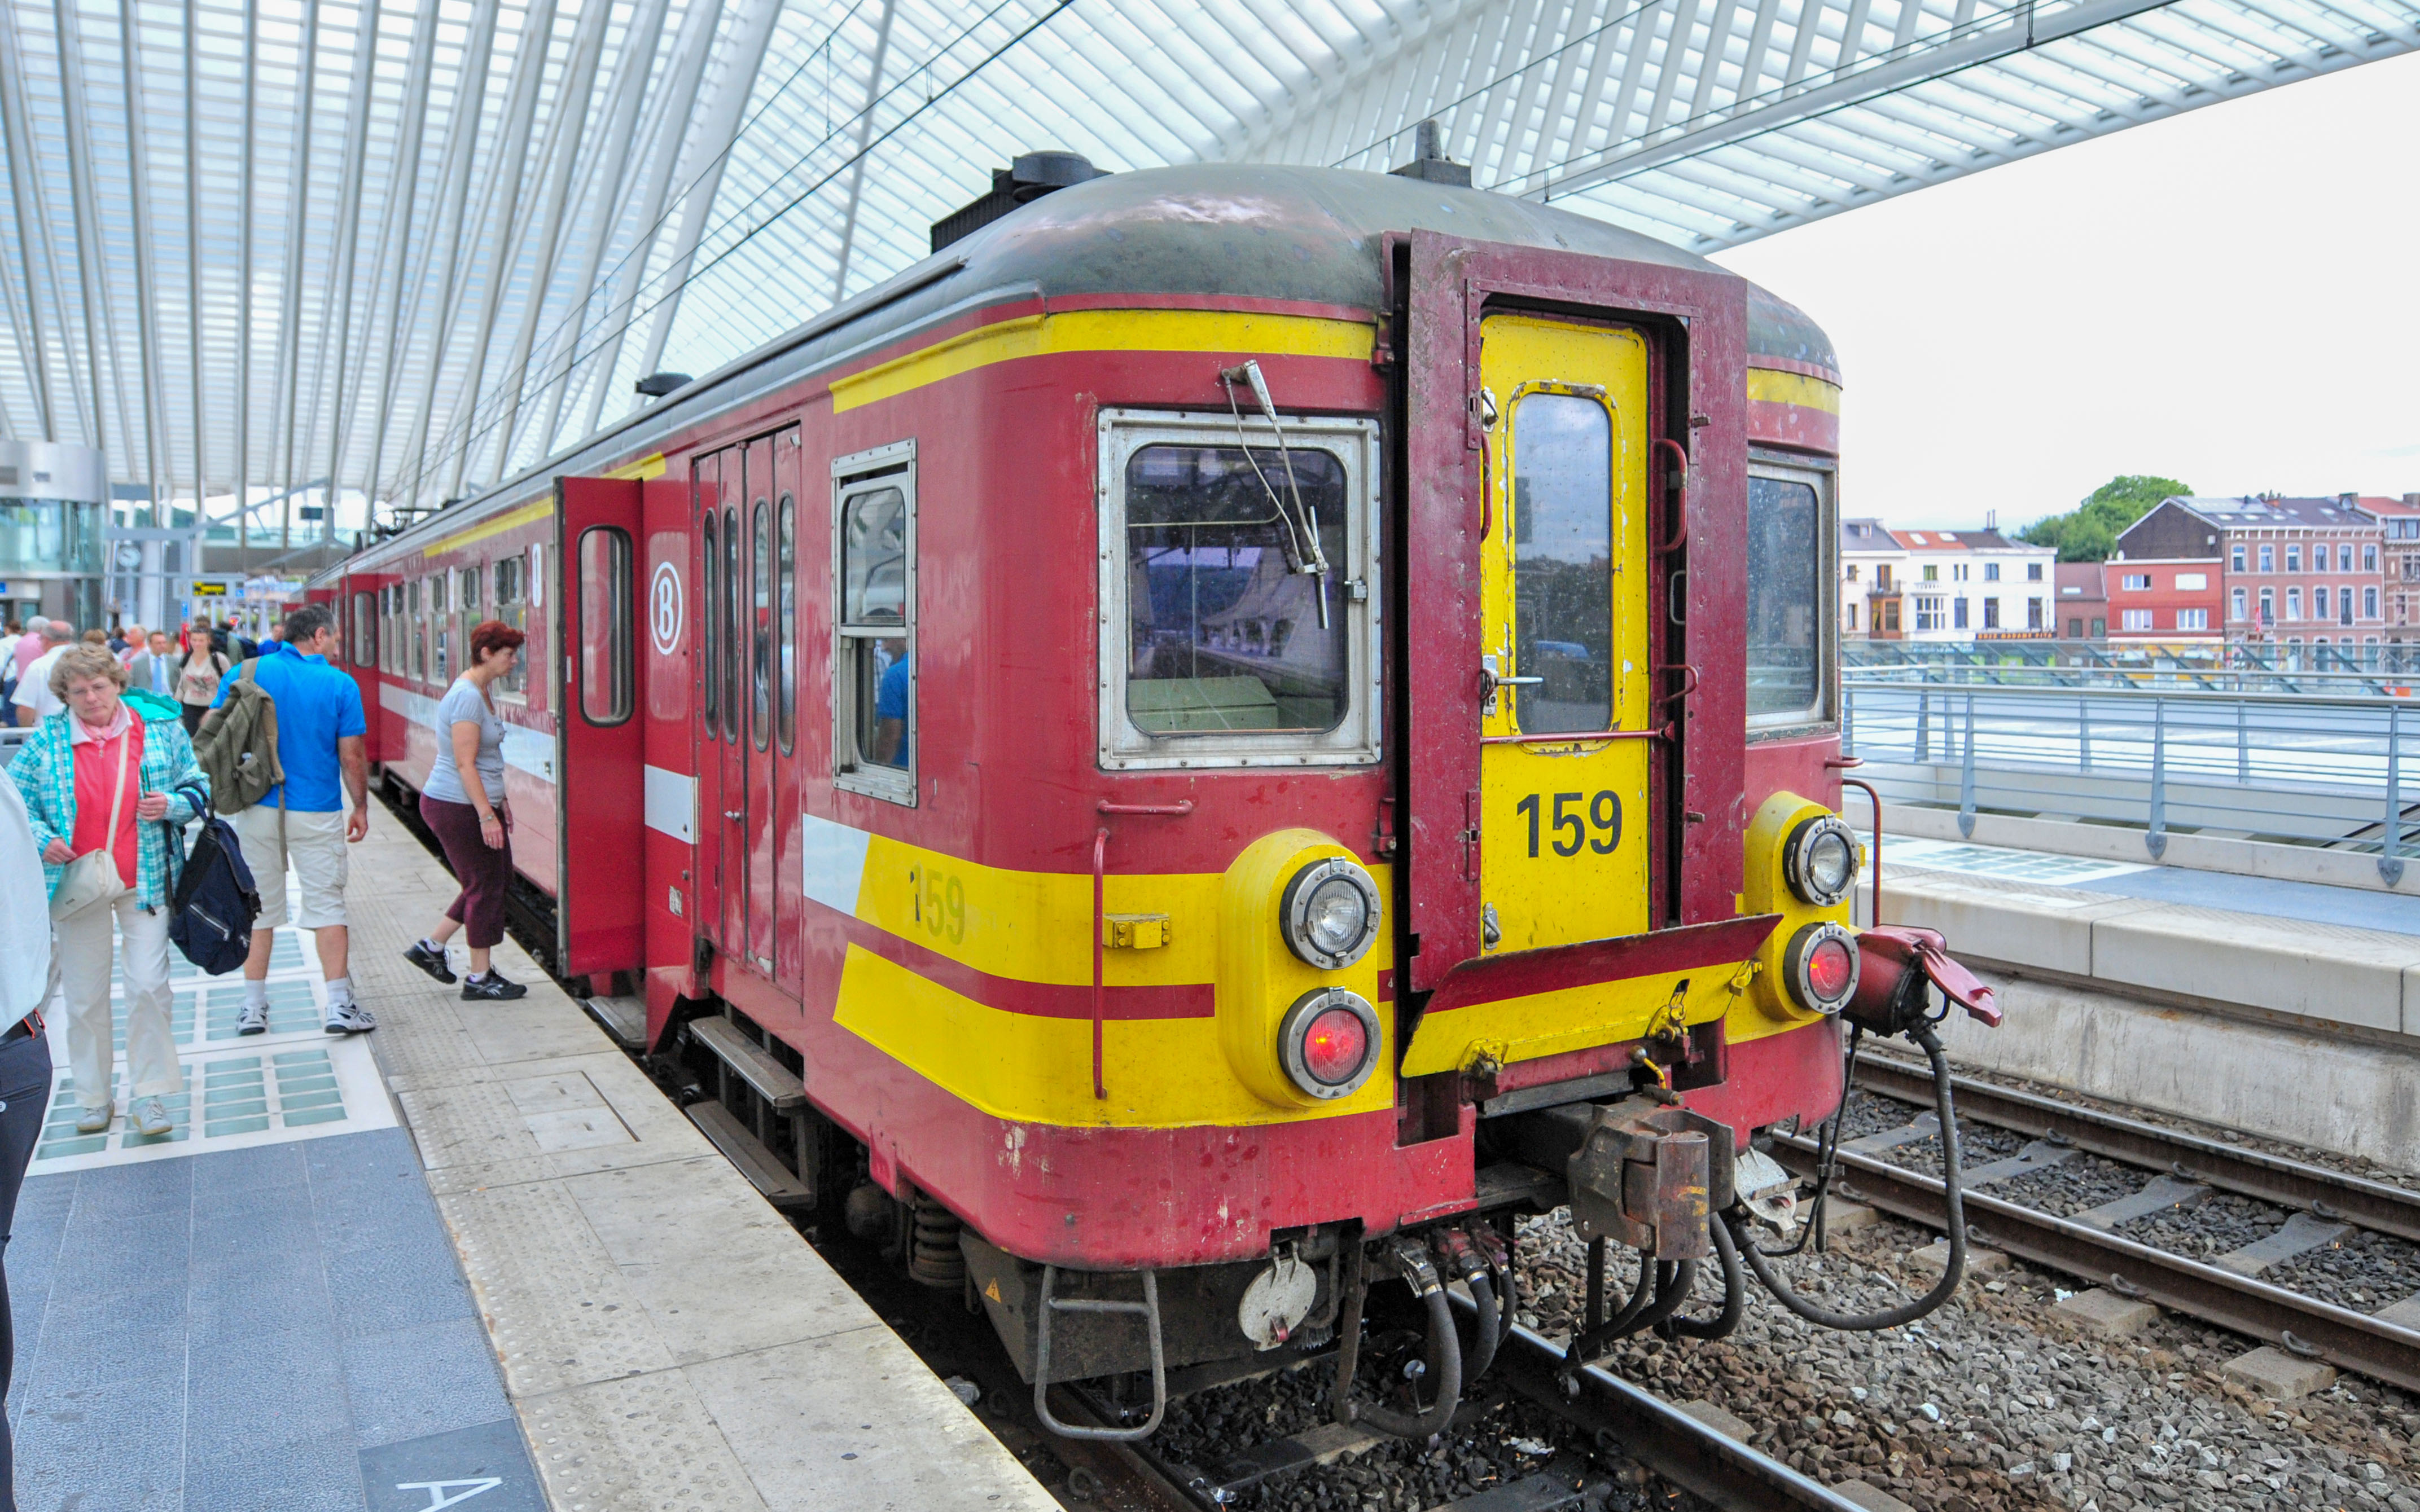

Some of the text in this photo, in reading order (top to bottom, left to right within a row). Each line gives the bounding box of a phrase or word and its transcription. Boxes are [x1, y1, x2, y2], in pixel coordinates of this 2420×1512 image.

[657, 576, 674, 640] B
[1516, 789, 1623, 858] 159
[909, 863, 965, 946] 159
[396, 1477, 503, 1512] A
